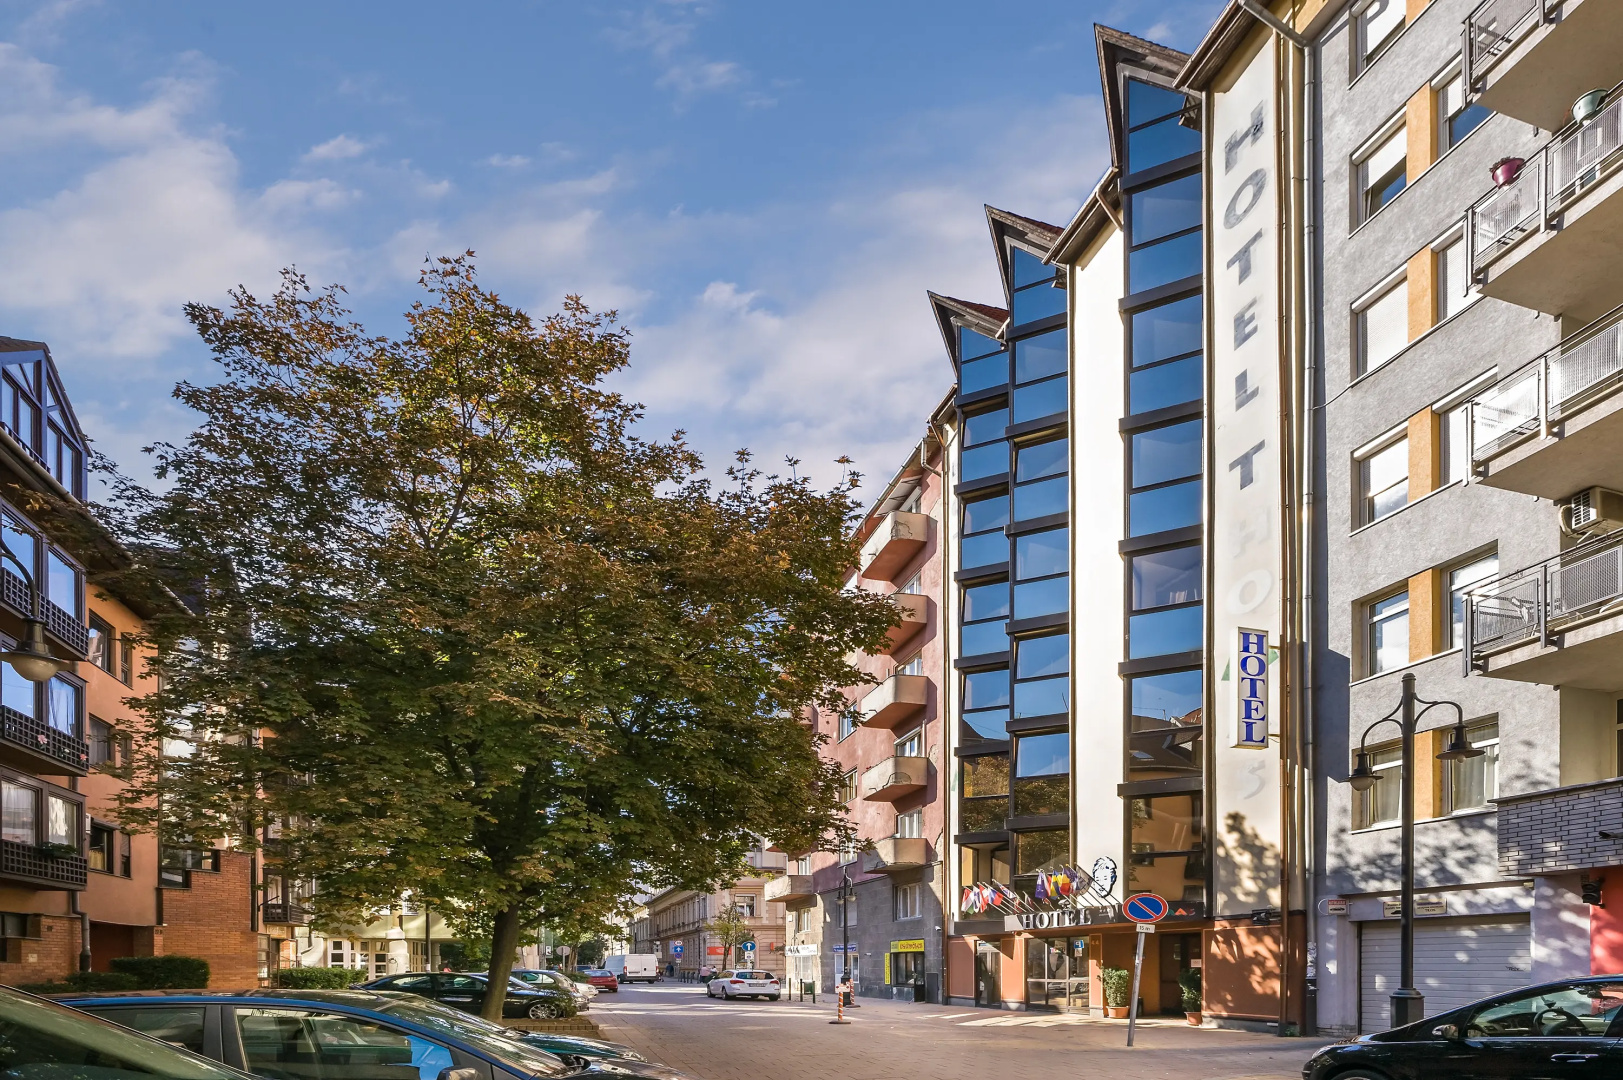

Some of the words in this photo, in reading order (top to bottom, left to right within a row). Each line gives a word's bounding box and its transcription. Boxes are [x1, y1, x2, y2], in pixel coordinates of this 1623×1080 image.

[1223, 99, 1267, 412] HOTEL
[1240, 631, 1267, 744] HOTEL
[1021, 907, 1092, 930] HOTEL
